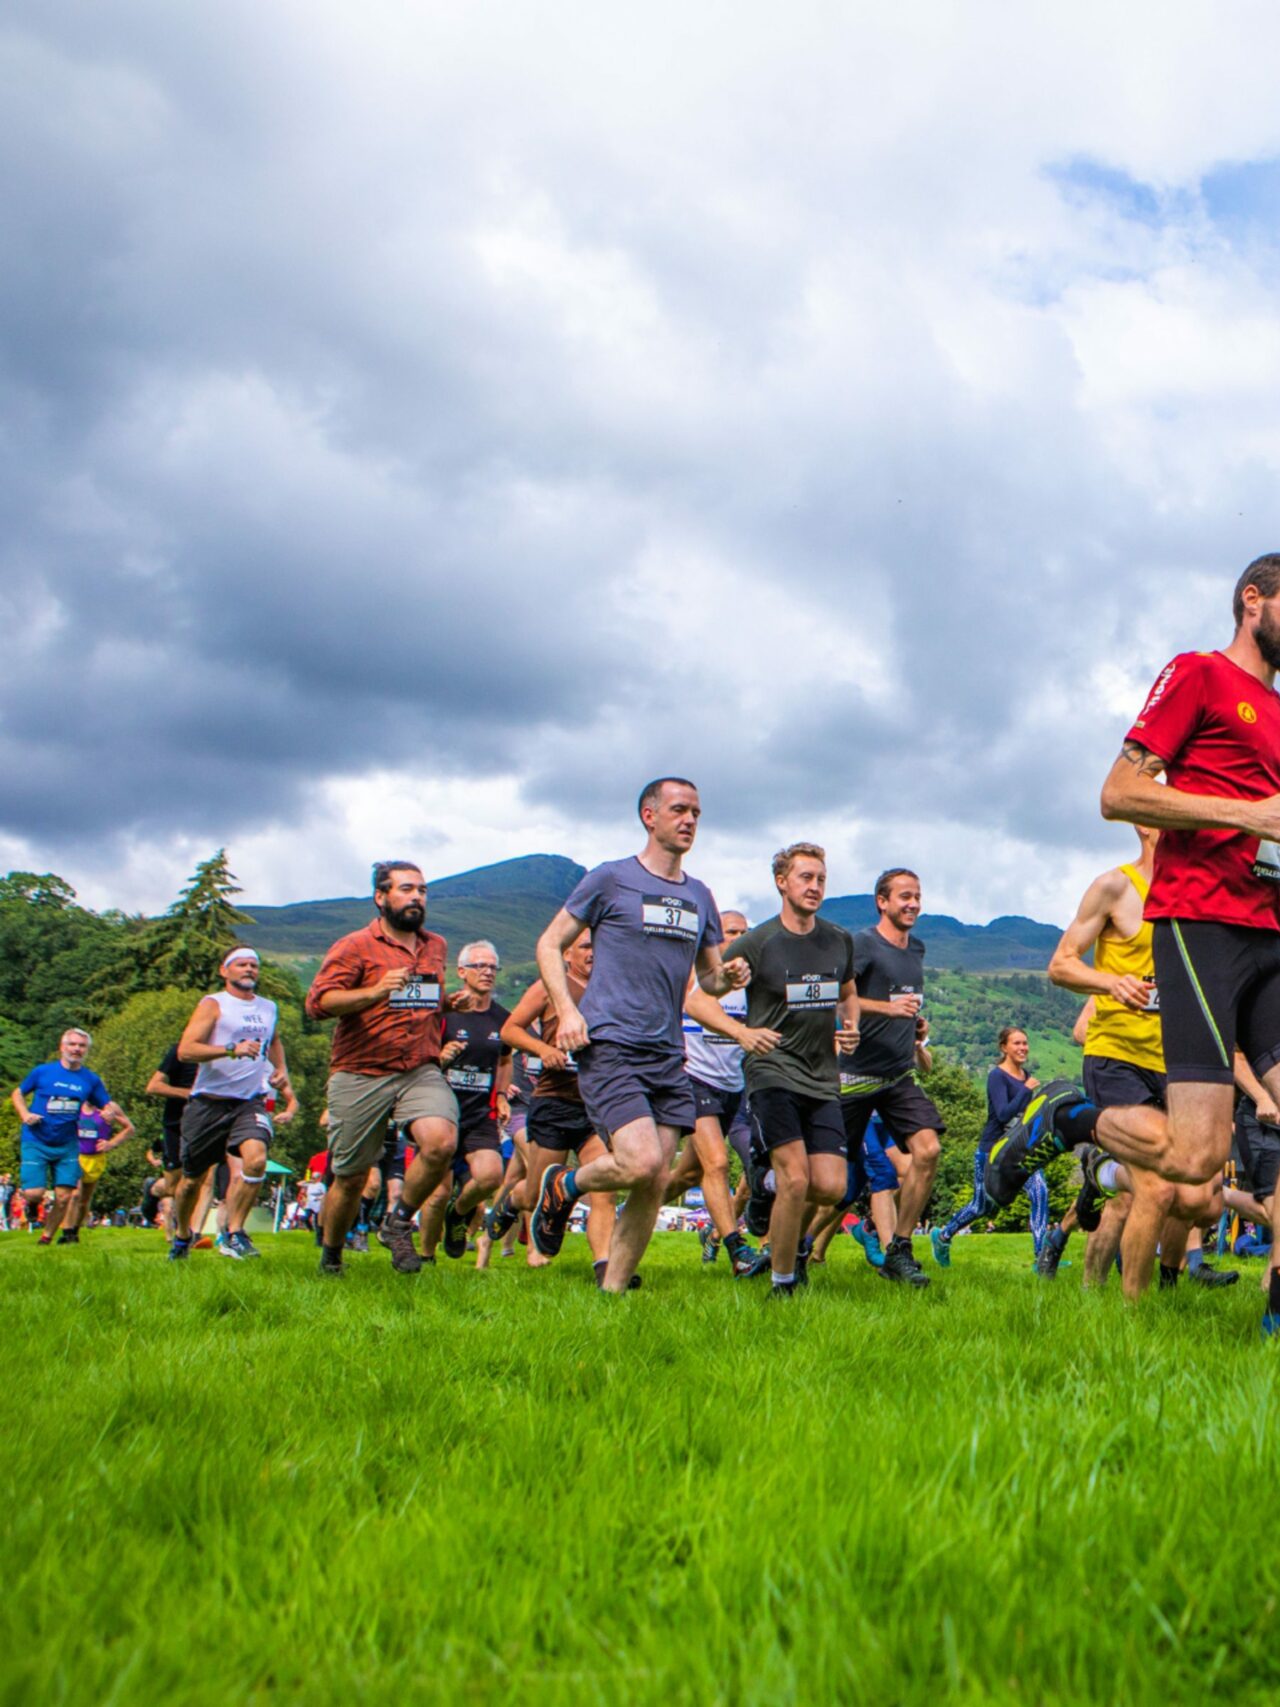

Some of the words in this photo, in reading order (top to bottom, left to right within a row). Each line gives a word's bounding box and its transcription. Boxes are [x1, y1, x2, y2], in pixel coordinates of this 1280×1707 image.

[665, 908, 682, 925] 37
[407, 984, 421, 999] 26
[805, 983, 821, 1000] 48
[243, 1014, 263, 1023] WEE
